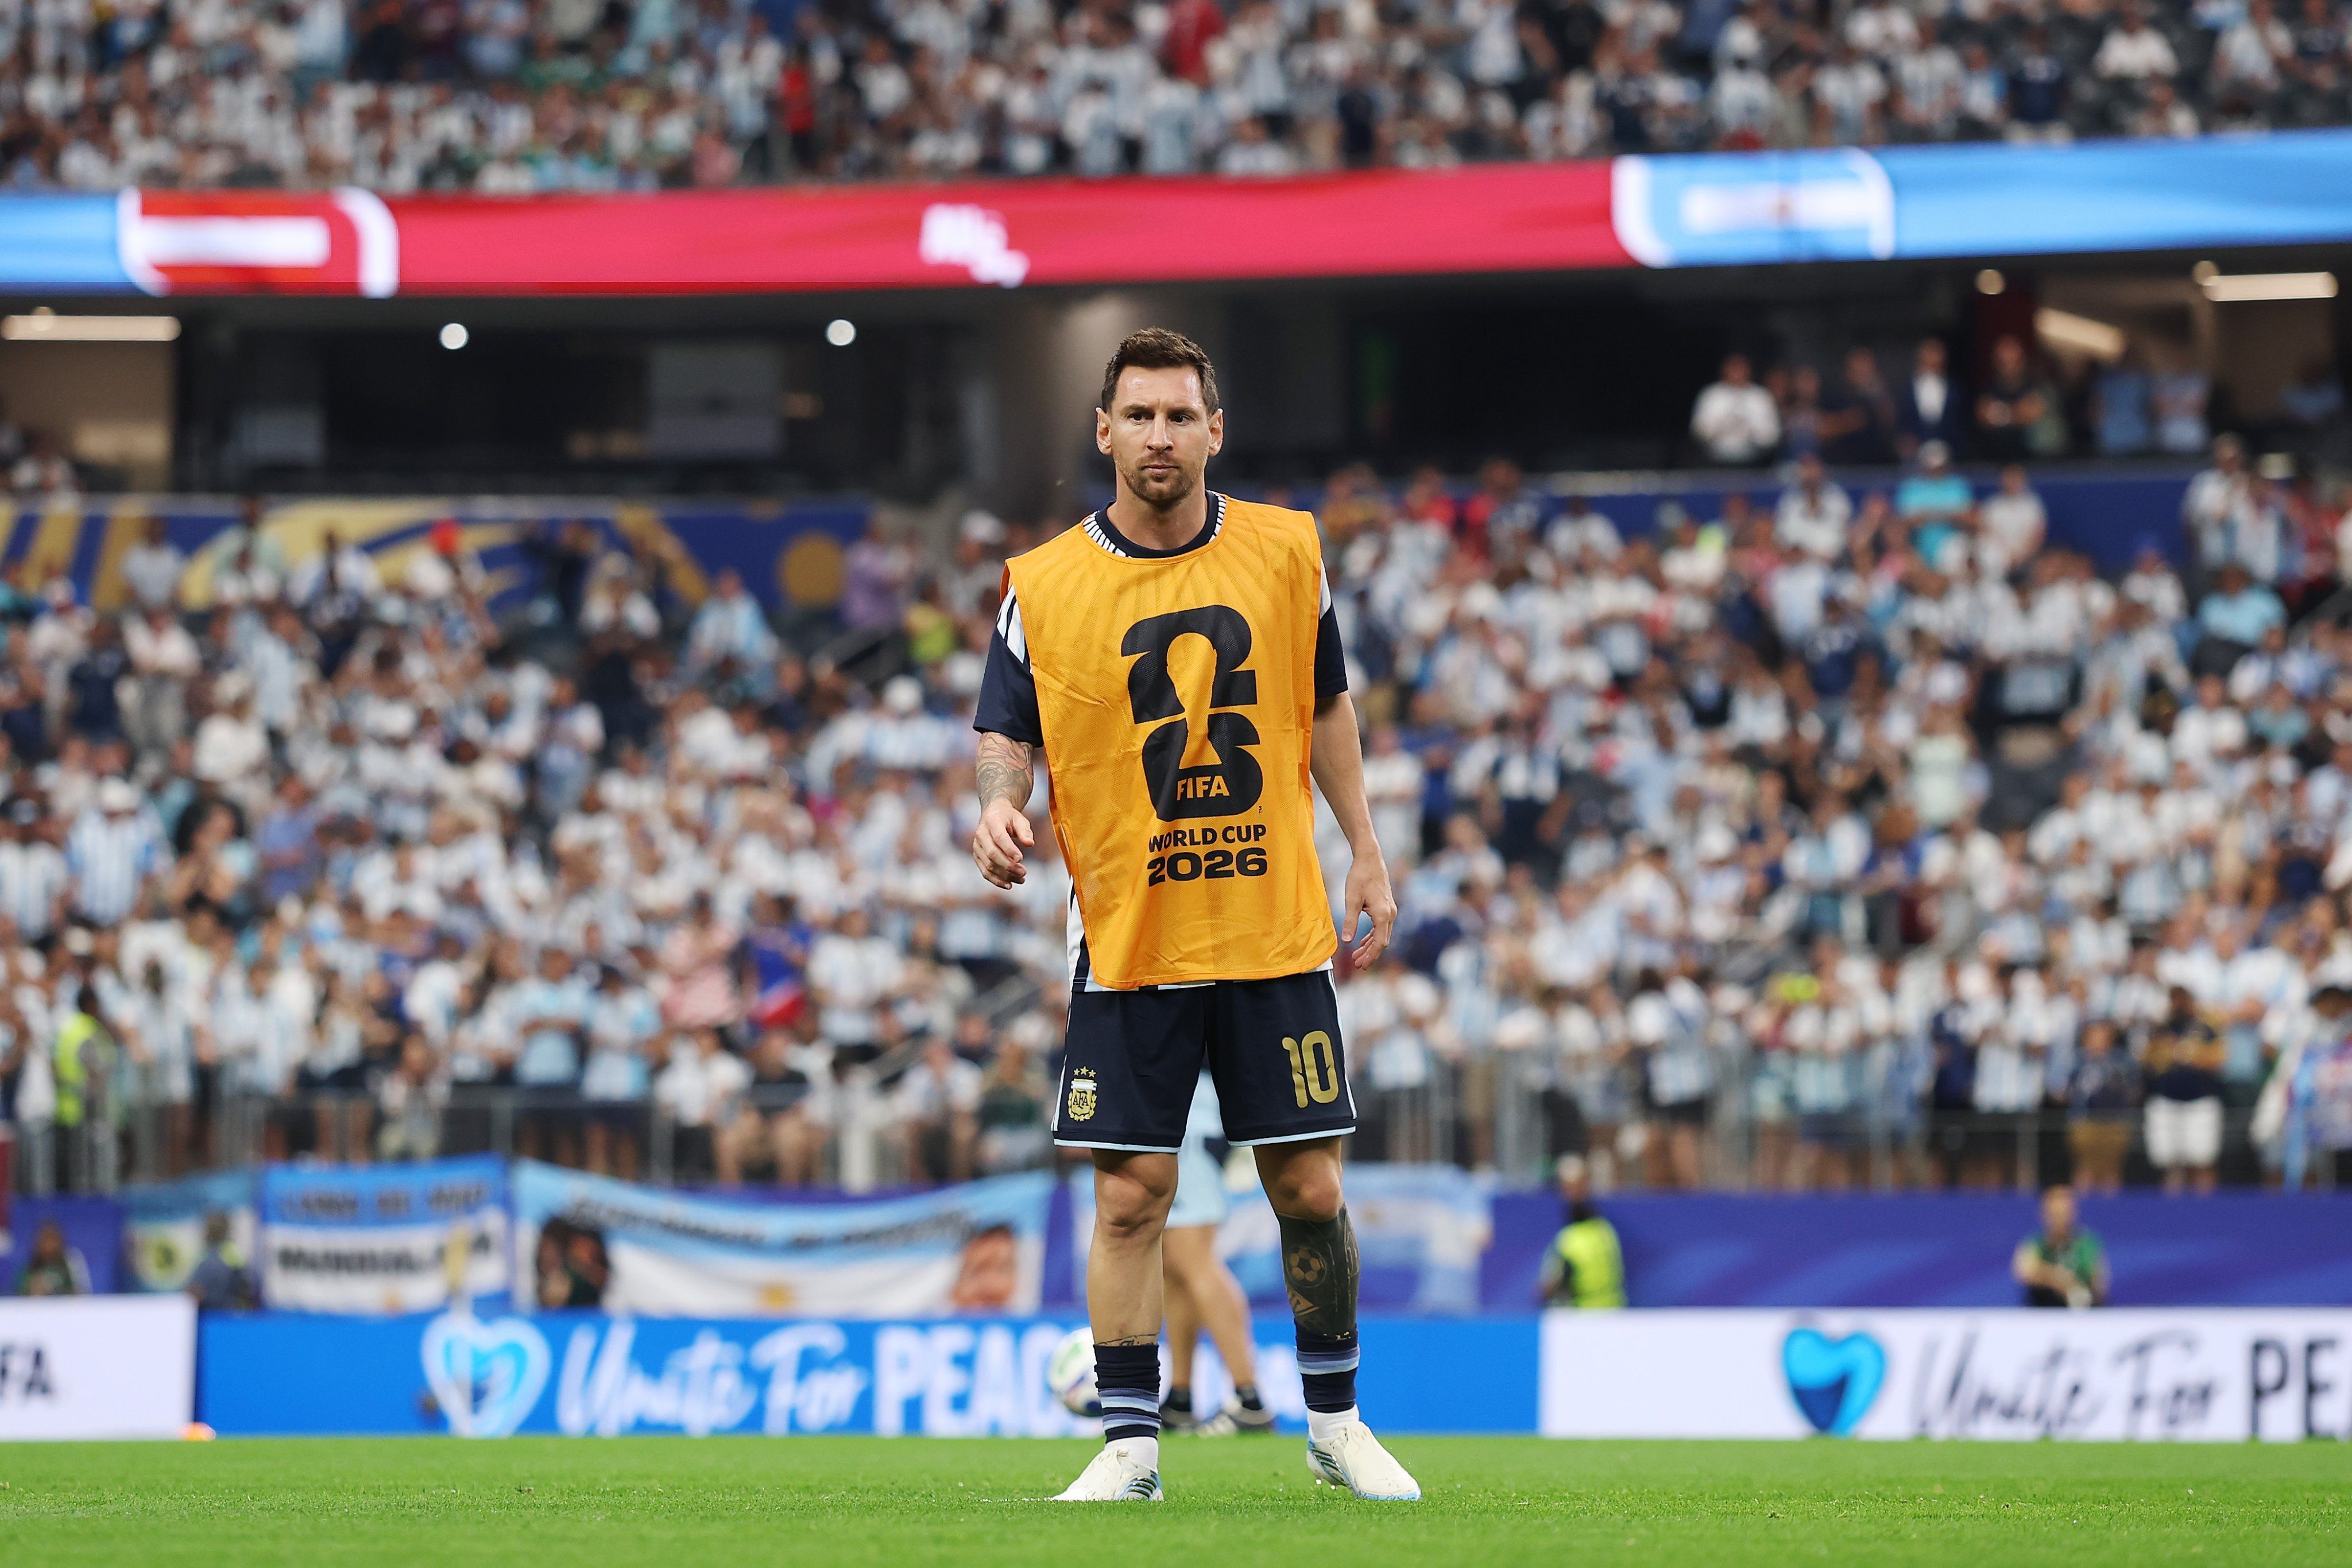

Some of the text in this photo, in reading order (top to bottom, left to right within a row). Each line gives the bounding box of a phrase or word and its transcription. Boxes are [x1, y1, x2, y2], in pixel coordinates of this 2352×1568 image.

[1176, 775, 1230, 801] FIFA
[1149, 824, 1267, 853] WORLD CUP
[1148, 847, 1268, 888] 2026
[1281, 1030, 1340, 1109] 10
[1072, 1090, 1089, 1109] AFA
[556, 1314, 757, 1438] Unite
[749, 1322, 869, 1438] For
[873, 1324, 1105, 1437] PEAC
[1910, 1325, 2352, 1440] Unite For PE
